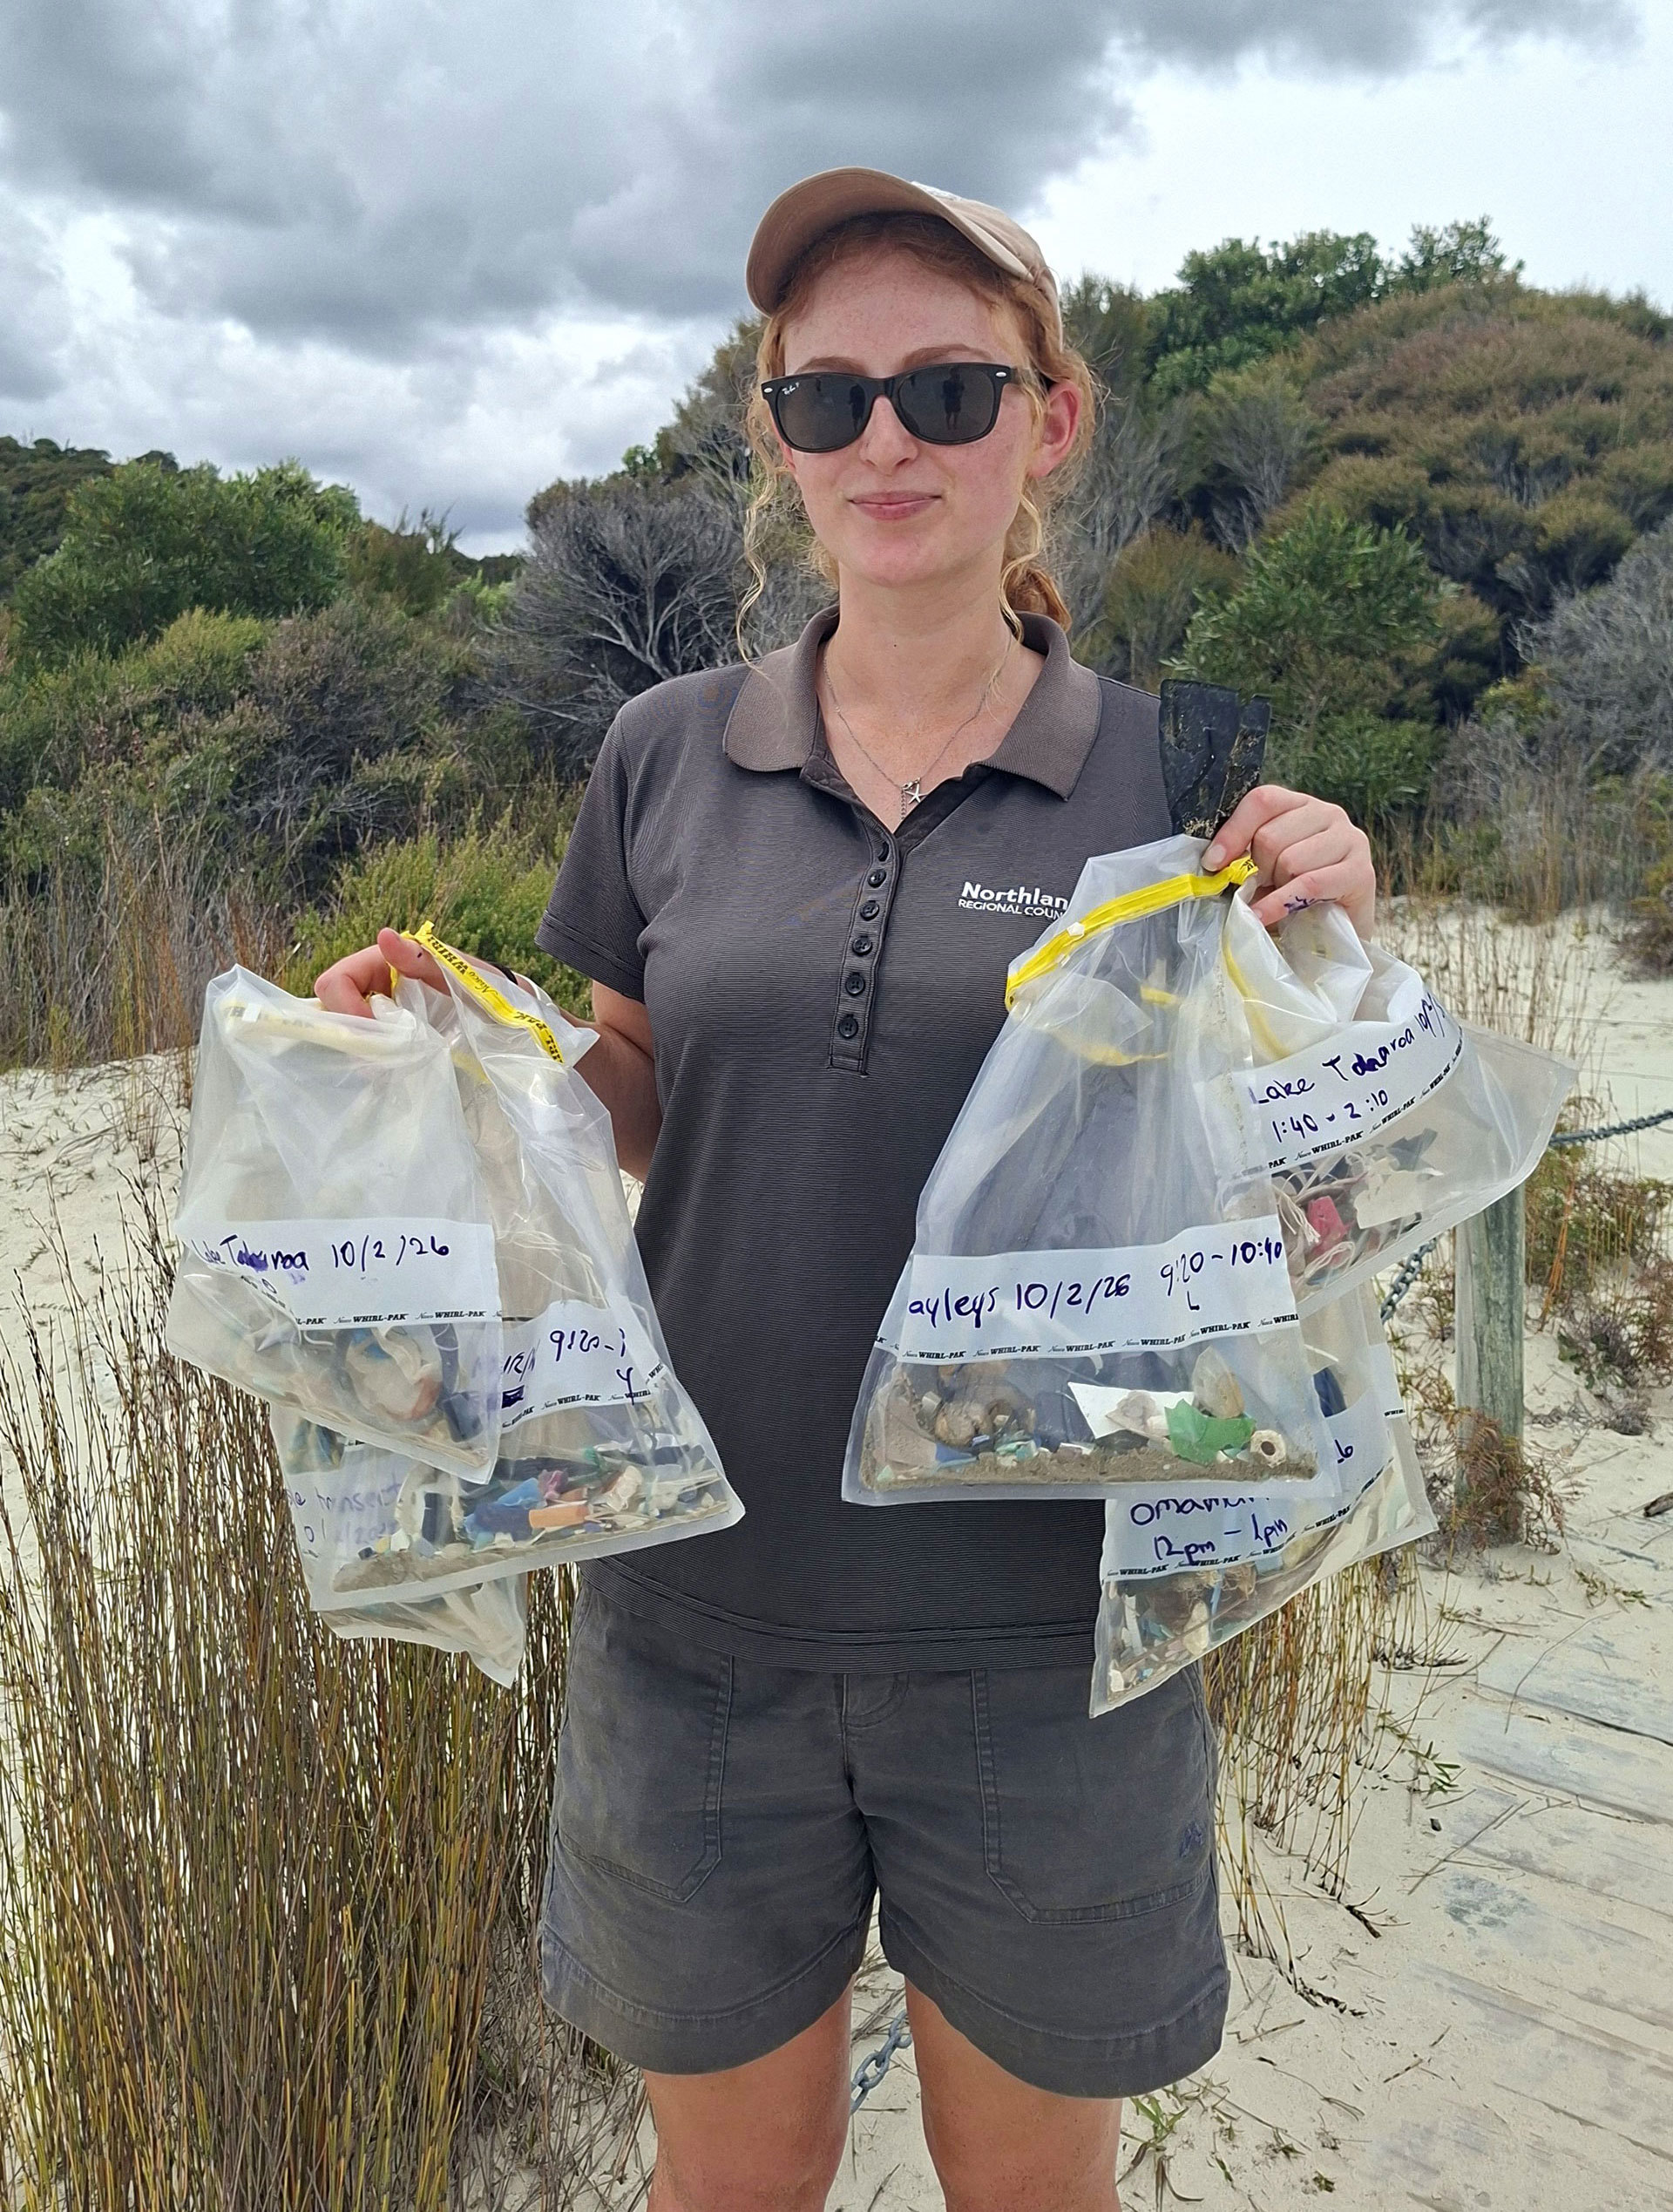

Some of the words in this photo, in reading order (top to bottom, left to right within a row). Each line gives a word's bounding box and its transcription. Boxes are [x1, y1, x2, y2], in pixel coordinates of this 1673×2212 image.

[958, 899, 1022, 914] REGIONAL
[1025, 906, 1064, 920] COUN
[962, 881, 1068, 910] Northlan
[427, 936, 469, 975] WHIR
[513, 1011, 564, 1063] IRL-PAK
[1249, 1077, 1315, 1104] Lake
[1268, 1157, 1287, 1170] PAK
[1311, 1131, 1364, 1154] WHIRL-PAK
[1381, 1096, 1416, 1124] WHIRL-PAK
[1272, 1113, 1318, 1143] 1:40
[295, 1317, 327, 1326] L-PAK
[353, 1313, 409, 1323] WHIRL-PAK
[435, 1310, 487, 1319] WHIRL-PAK
[908, 1286, 999, 1329] ayleys
[918, 1350, 967, 1360] WHIRL-PAK
[990, 1345, 1042, 1355] WHIRL-PAK
[1066, 1340, 1116, 1353] WHIRL-PAK
[1141, 1334, 1186, 1347] WHIRL-PAK
[1200, 1320, 1251, 1334] WHIRL-PAK
[557, 1394, 601, 1405] WHIRL-PAK
[1334, 1439, 1354, 1464] 6
[1119, 1564, 1169, 1576] WHIRL-PAK
